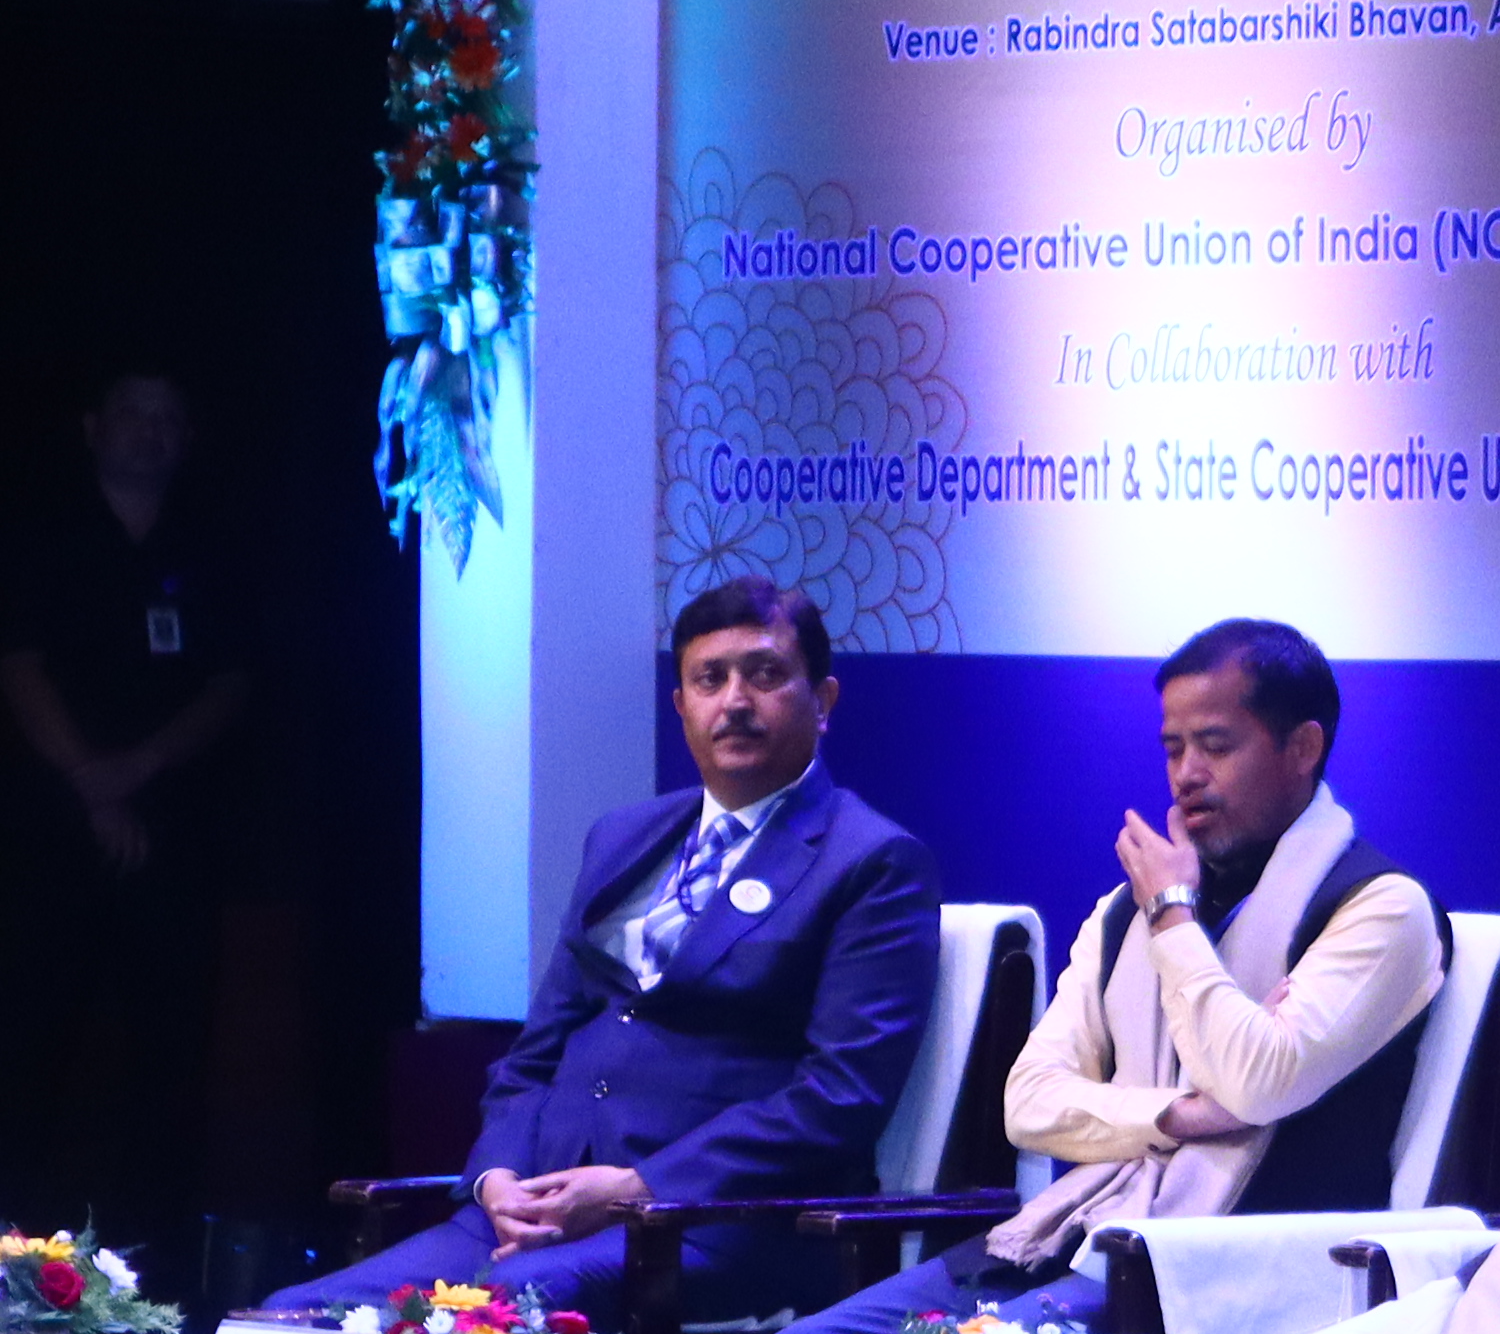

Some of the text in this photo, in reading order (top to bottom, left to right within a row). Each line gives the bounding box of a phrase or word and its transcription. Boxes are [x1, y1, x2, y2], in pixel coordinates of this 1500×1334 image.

[884, 22, 979, 59] Venue
[1006, 13, 1140, 53] Rabindra
[1150, 3, 1339, 47] Satabarshiki
[1349, 0, 1477, 38] Bhavan,
[1115, 90, 1372, 177] Organised by
[723, 224, 877, 278] National
[888, 223, 1129, 282] Cooperative
[1144, 220, 1251, 268] Union
[1267, 216, 1304, 264] of
[1318, 213, 1418, 262] India
[1053, 316, 1434, 391] In Collaboration with
[710, 439, 906, 516] Cooperative
[916, 439, 1111, 516] Department
[1121, 442, 1142, 502] &
[1155, 438, 1238, 502] State
[1249, 434, 1469, 516] Cooperative
